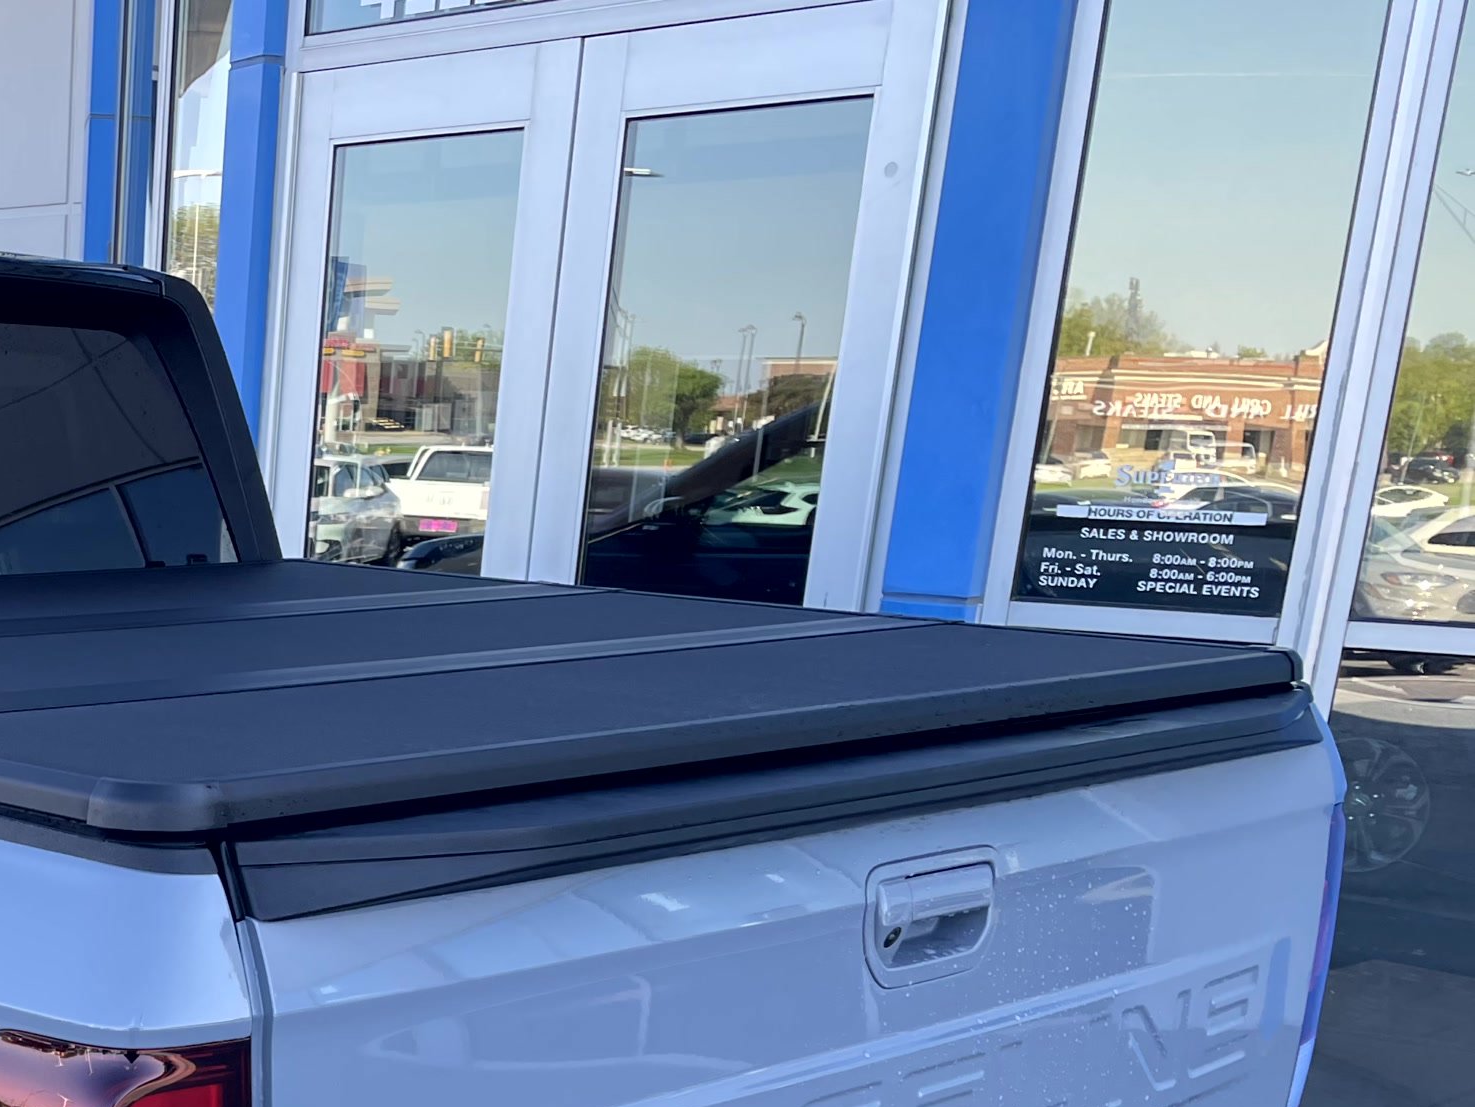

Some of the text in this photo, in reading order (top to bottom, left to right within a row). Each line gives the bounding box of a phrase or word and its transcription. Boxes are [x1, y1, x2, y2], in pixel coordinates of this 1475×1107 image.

[1087, 506, 1132, 519] HOURS
[1136, 508, 1154, 520] OF
[1080, 527, 1234, 545] SALES & SHOWROOM
[1043, 547, 1077, 560] Mon.
[1090, 549, 1133, 563] Thurs.
[1152, 553, 1197, 566] 8:00AM
[1208, 556, 1254, 569] 8:00PM
[1040, 562, 1062, 574] Fri.
[1074, 564, 1101, 576] Sat.
[1149, 568, 1194, 580] 8:00AM
[1206, 571, 1251, 583] 6:00PM
[1038, 575, 1260, 598] SUNDAY SPECIAL EVENTS
